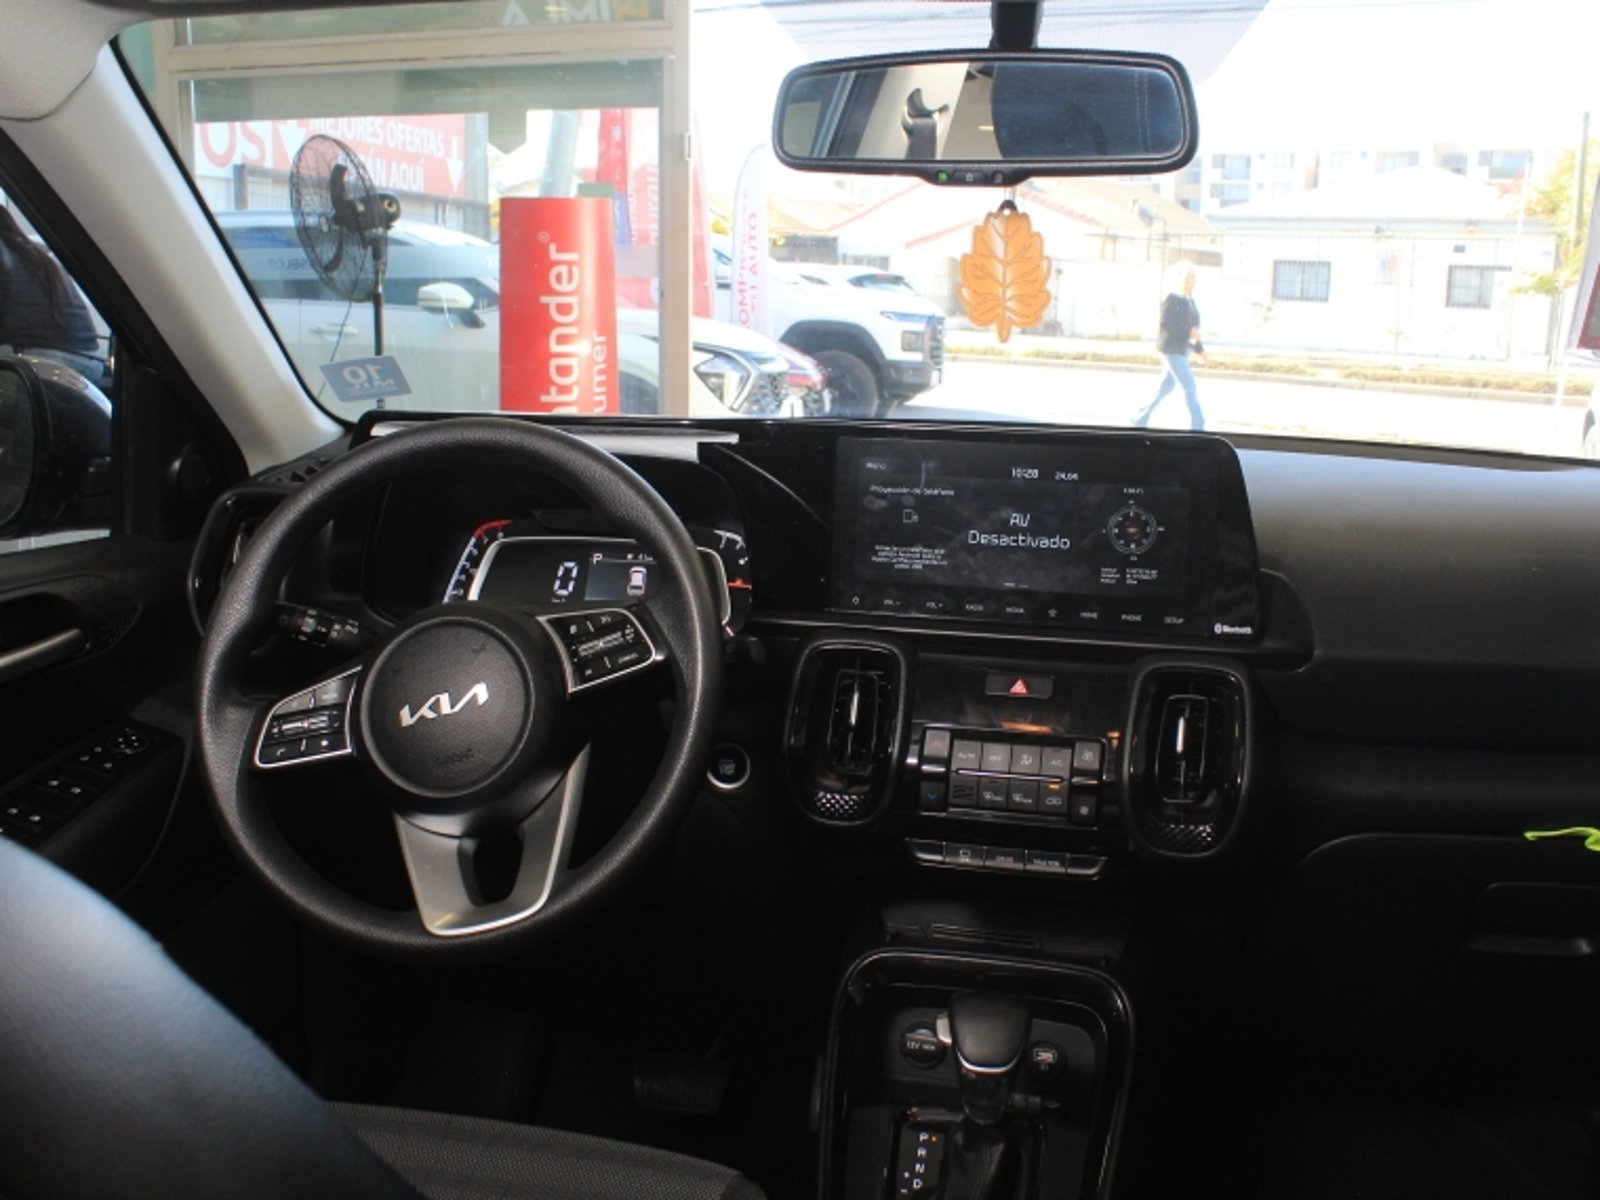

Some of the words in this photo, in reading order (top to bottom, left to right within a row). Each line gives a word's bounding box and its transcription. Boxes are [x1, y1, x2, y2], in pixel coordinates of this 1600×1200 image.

[386, 121, 446, 158] OFERTAS
[539, 242, 581, 414] tander
[1009, 512, 1031, 528] AV
[967, 530, 1071, 550] Desactivado
[593, 552, 603, 565] P
[400, 682, 489, 728] KIA
[919, 1132, 929, 1143] P
[917, 1147, 927, 1158] R
[915, 1163, 926, 1174] N
[912, 1179, 923, 1190] D
